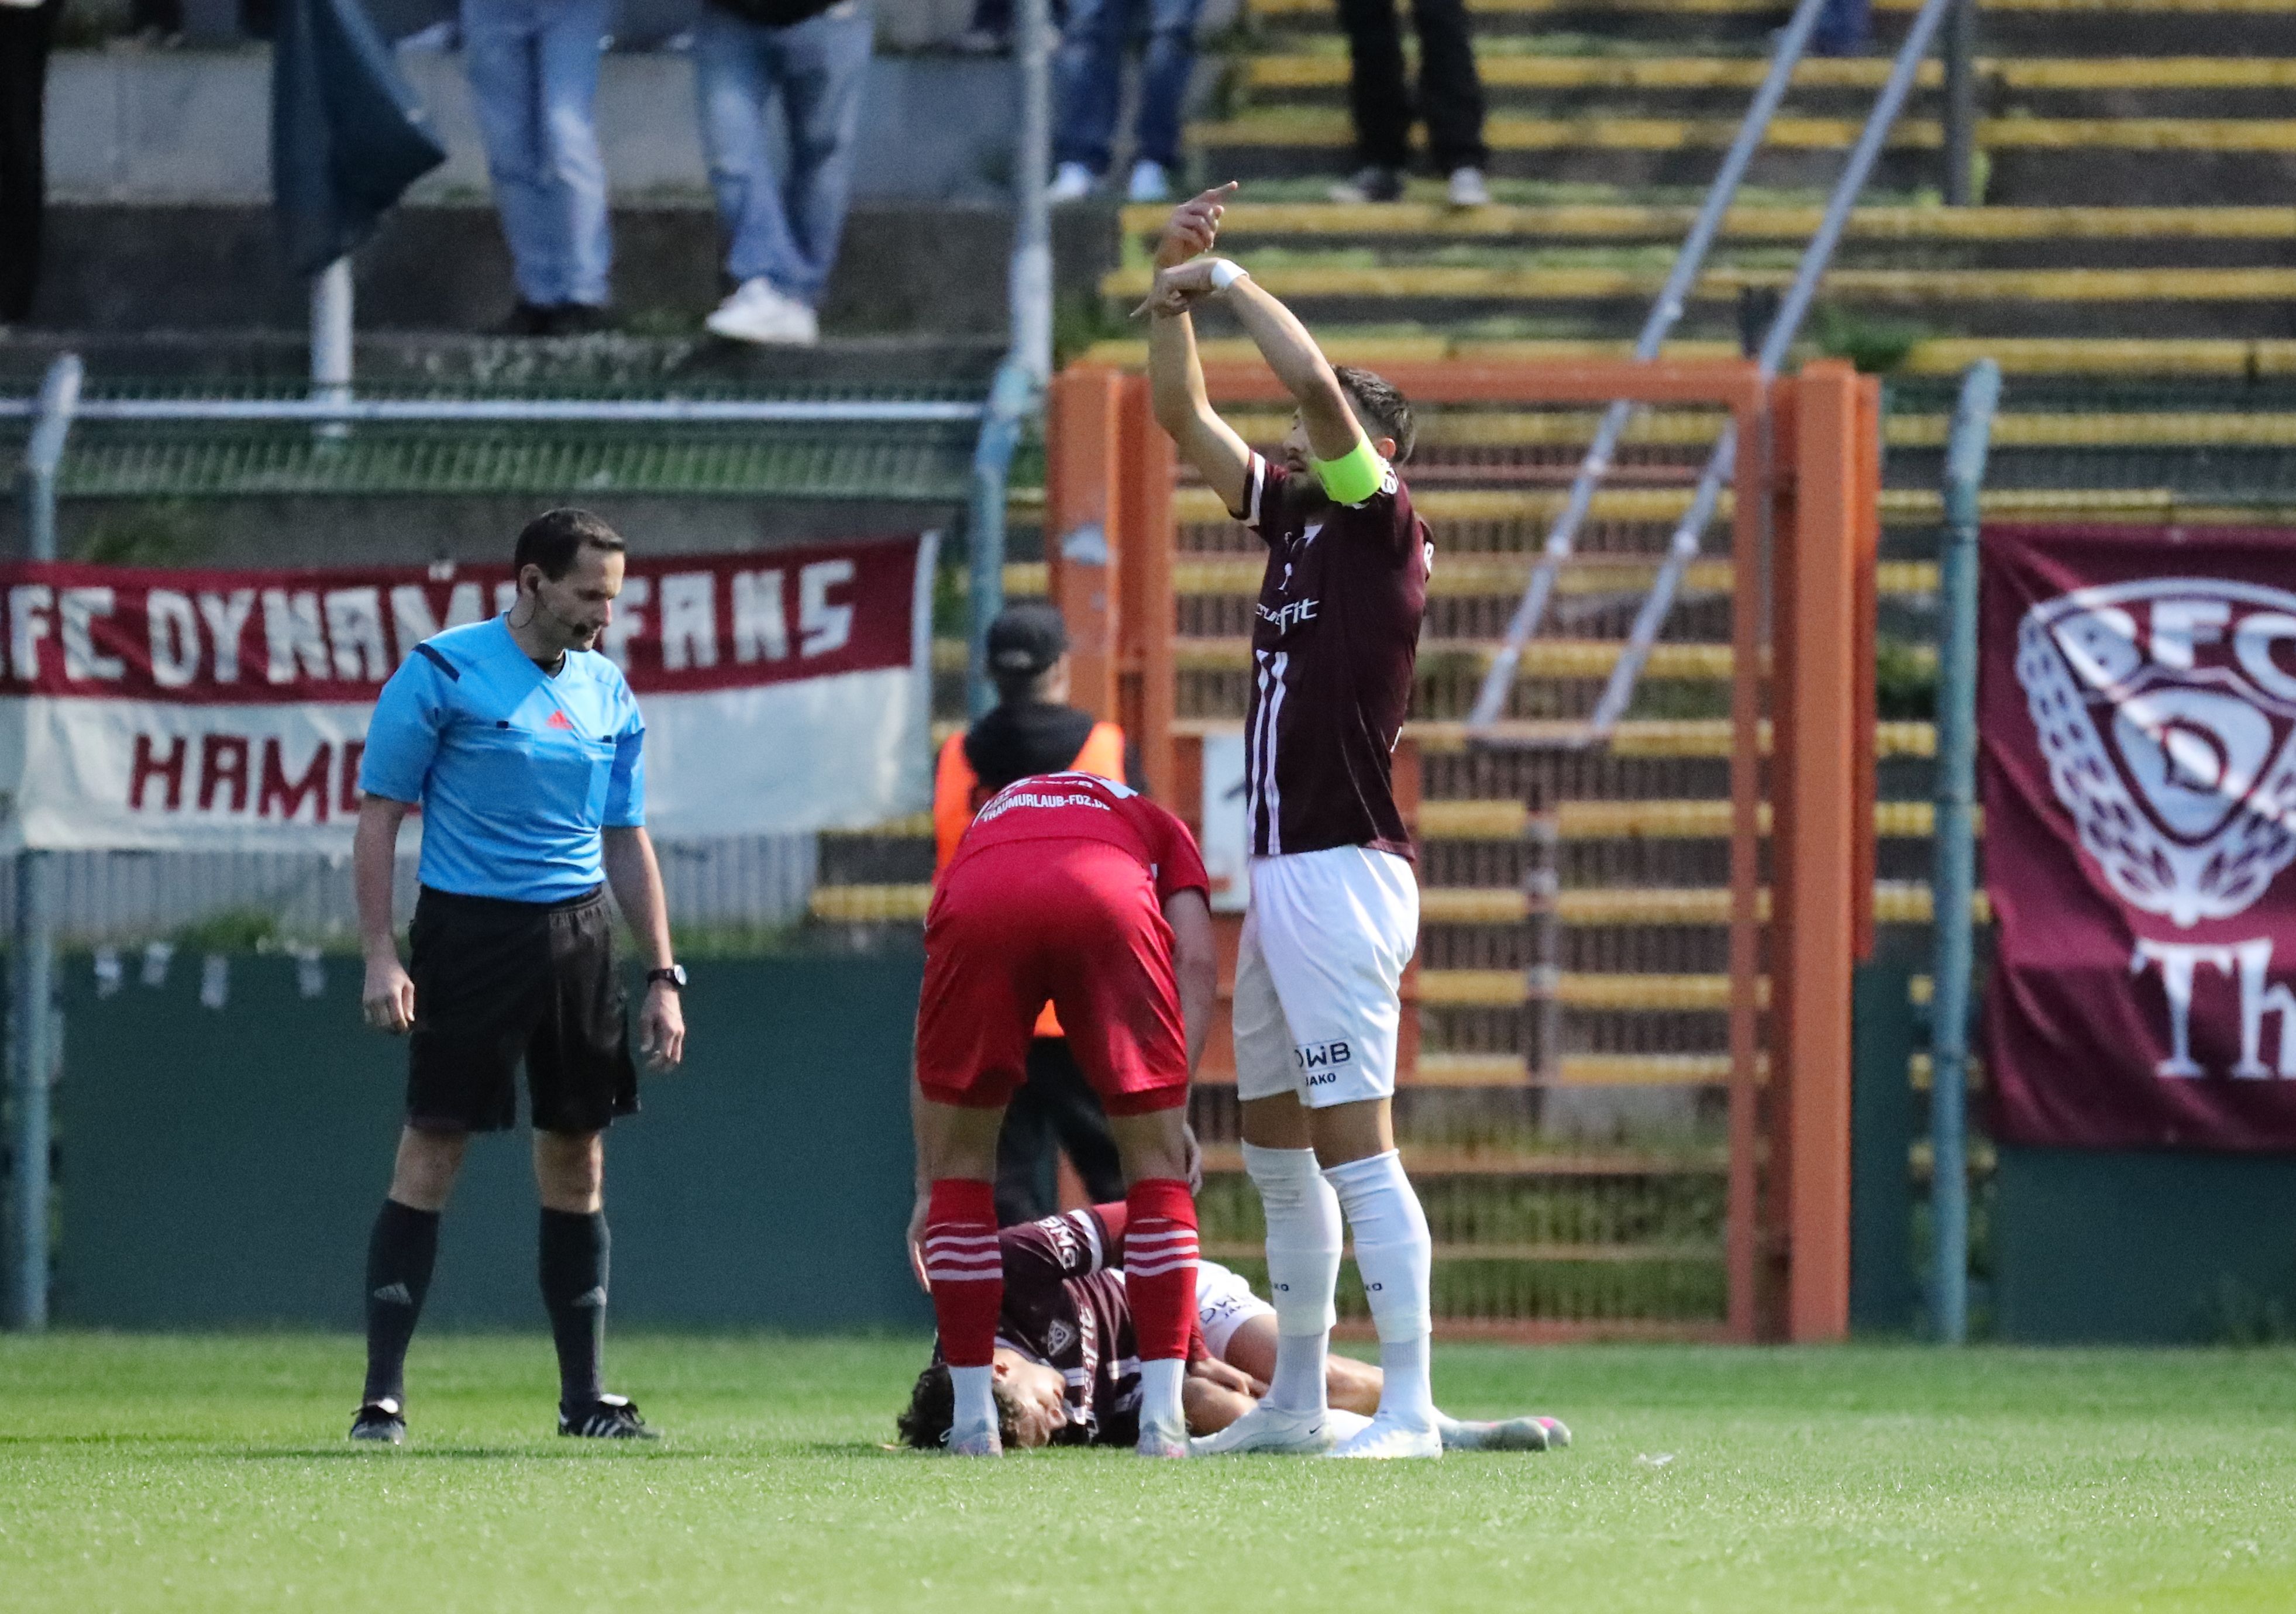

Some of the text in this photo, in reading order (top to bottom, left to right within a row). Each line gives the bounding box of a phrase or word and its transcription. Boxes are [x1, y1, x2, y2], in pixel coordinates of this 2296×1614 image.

[0, 559, 855, 687] FC DYNAM FANS
[130, 734, 422, 824] HAM
